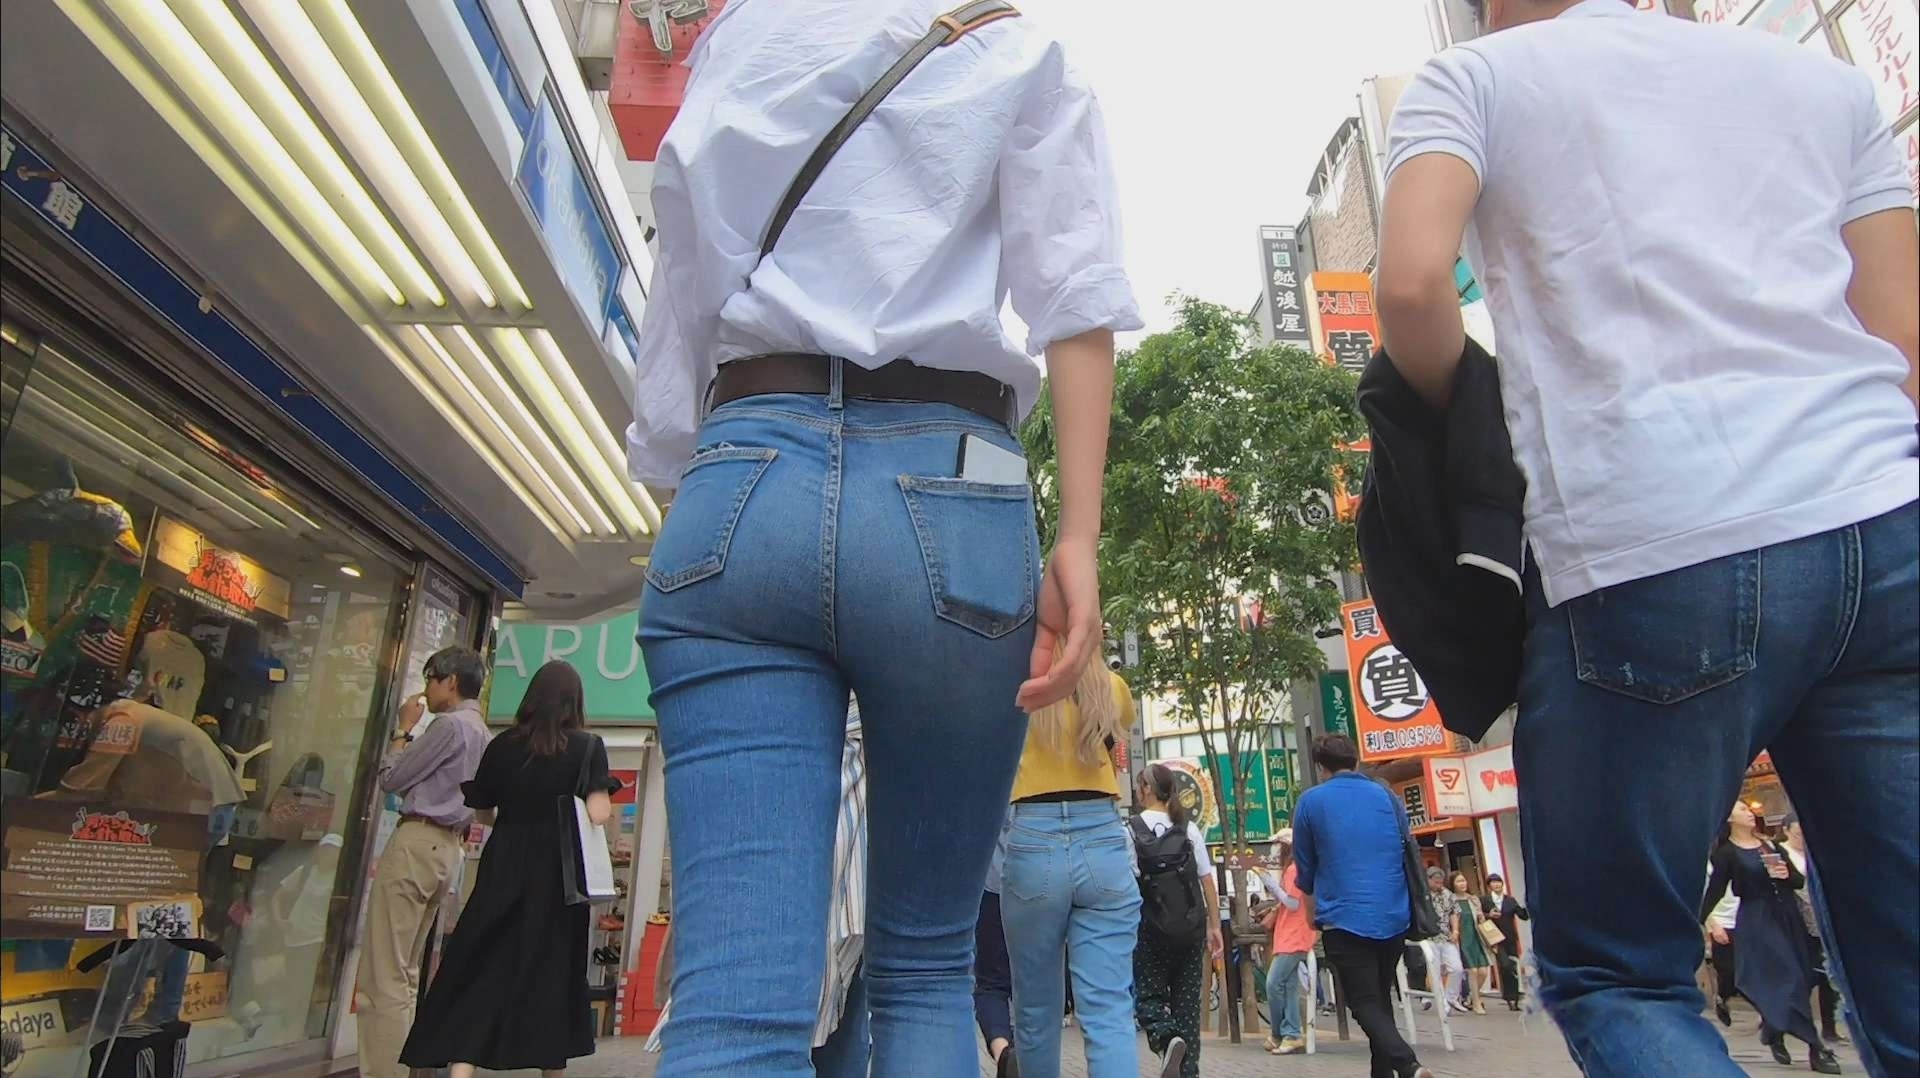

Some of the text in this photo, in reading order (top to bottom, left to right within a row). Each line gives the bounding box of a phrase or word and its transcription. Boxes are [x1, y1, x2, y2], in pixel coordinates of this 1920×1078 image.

[1273, 269, 1305, 333] 越後屋
[1317, 291, 1372, 315] 大黒屋
[1366, 653, 1428, 714] 質
